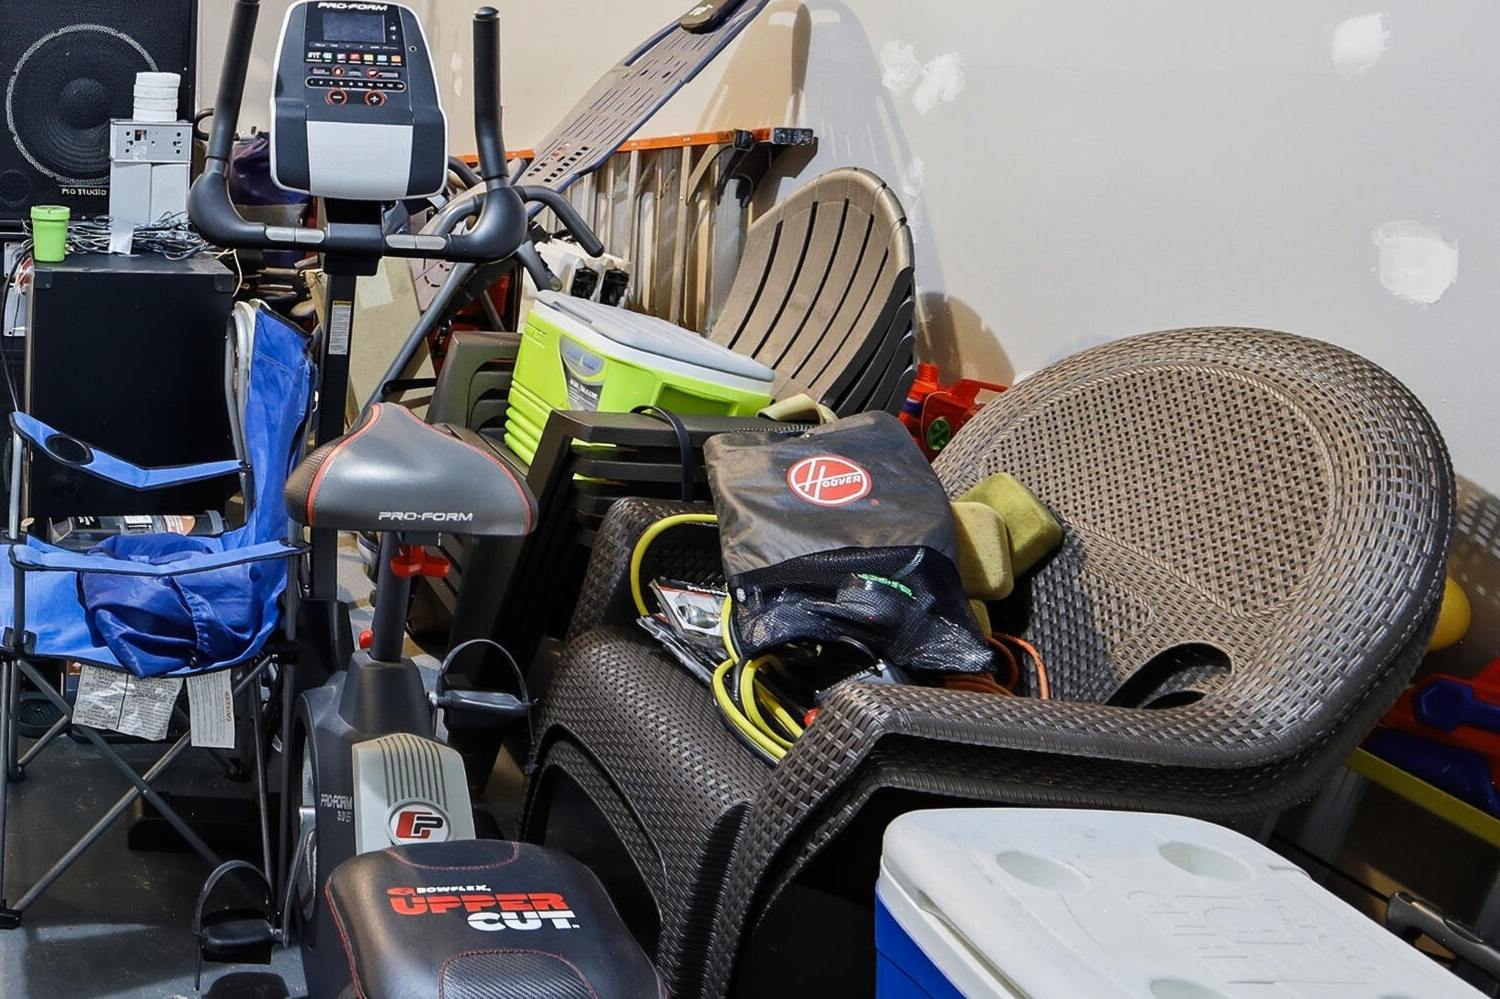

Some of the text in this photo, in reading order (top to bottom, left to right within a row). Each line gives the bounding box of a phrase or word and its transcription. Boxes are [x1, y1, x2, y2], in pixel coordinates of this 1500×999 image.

[318, 2, 388, 11] PRO-FORM
[378, 511, 474, 522] PRO-FORM
[416, 884, 491, 894] BOWFLEX
[390, 892, 569, 915] UPPER
